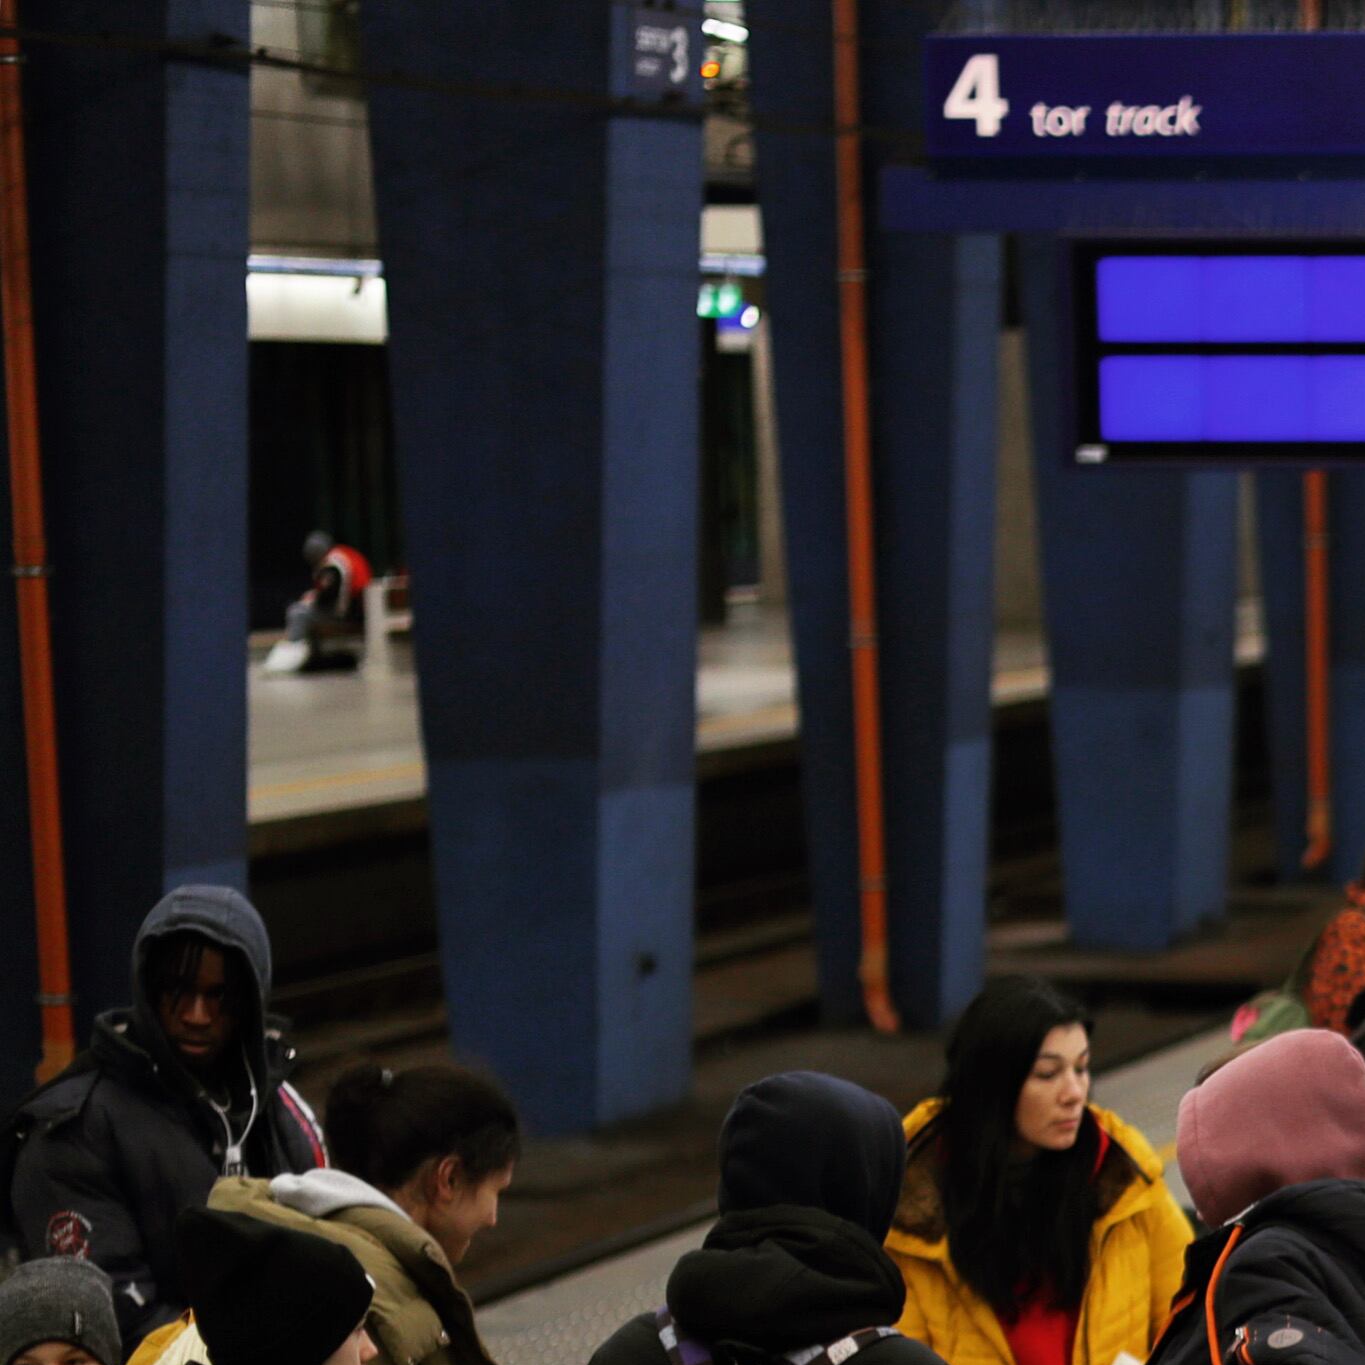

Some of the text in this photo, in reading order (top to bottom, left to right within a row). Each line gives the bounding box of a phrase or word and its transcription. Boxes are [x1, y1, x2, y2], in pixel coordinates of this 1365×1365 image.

[943, 53, 1201, 137] 4 tor track
